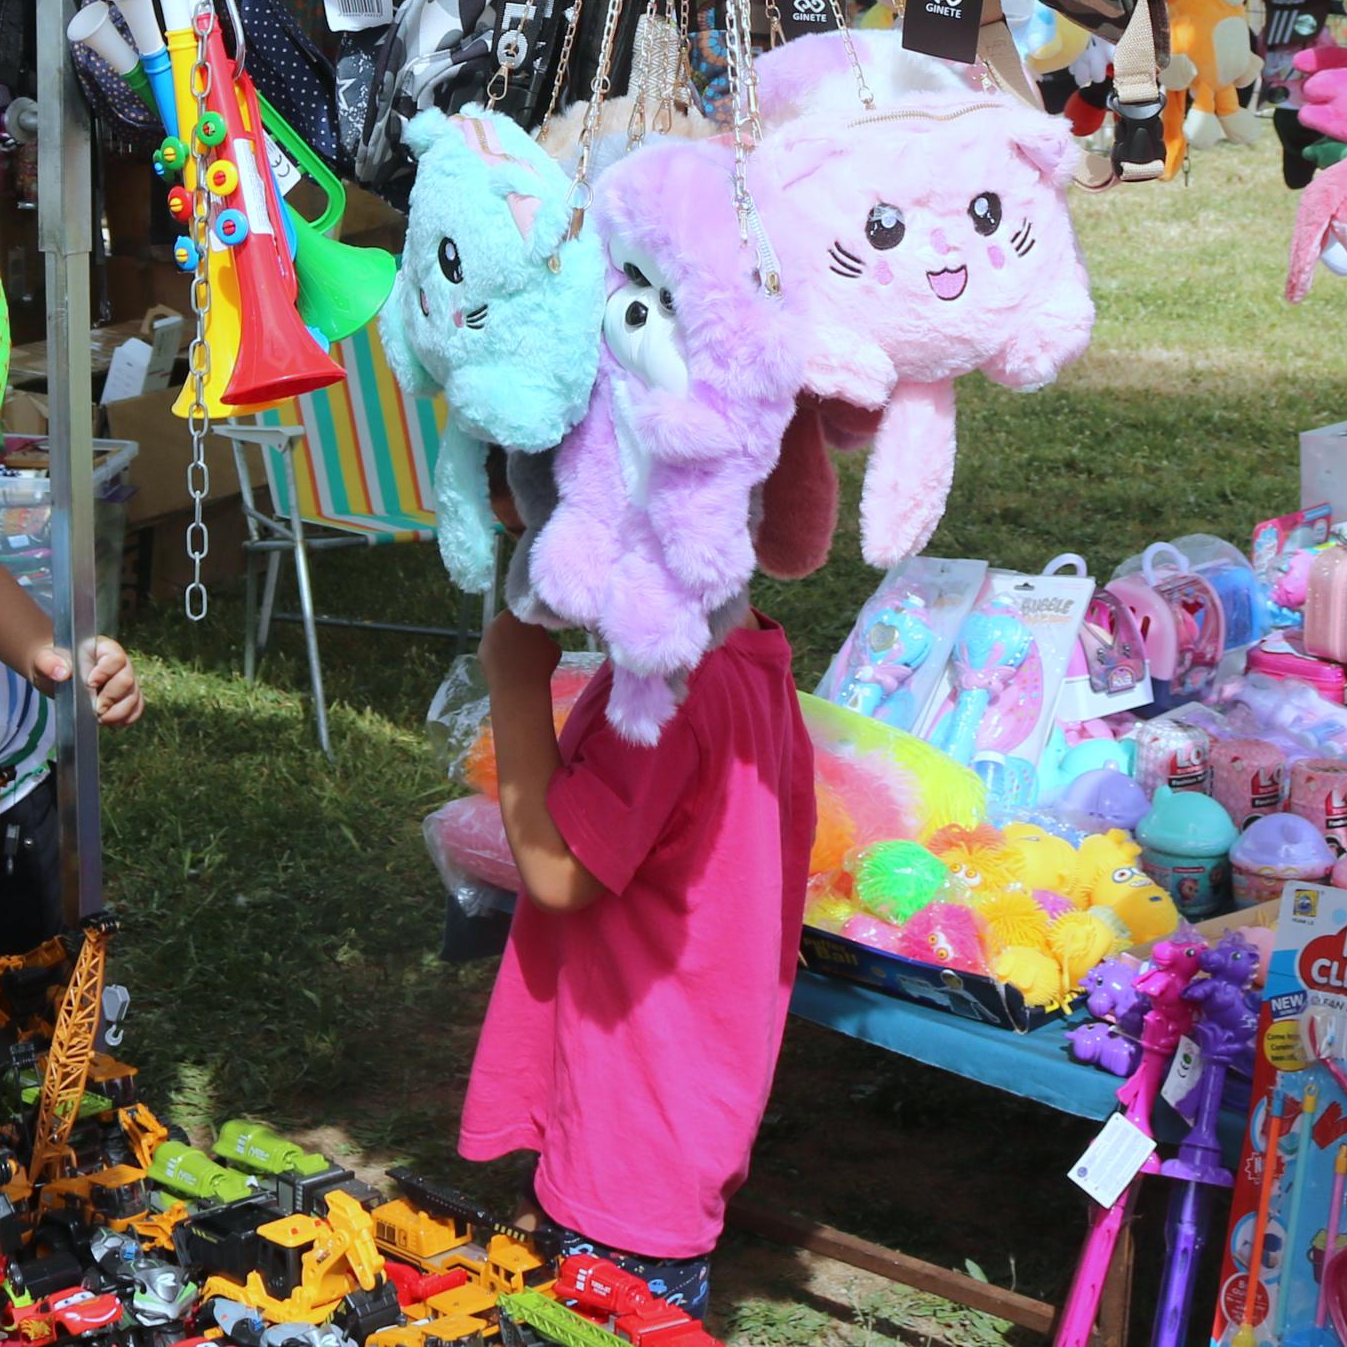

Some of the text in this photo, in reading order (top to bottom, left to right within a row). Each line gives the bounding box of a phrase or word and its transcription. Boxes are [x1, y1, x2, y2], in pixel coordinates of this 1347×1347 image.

[793, 11, 828, 23] GINETE
[925, 2, 963, 19] GINETE
[1271, 993, 1305, 1012] NEW
